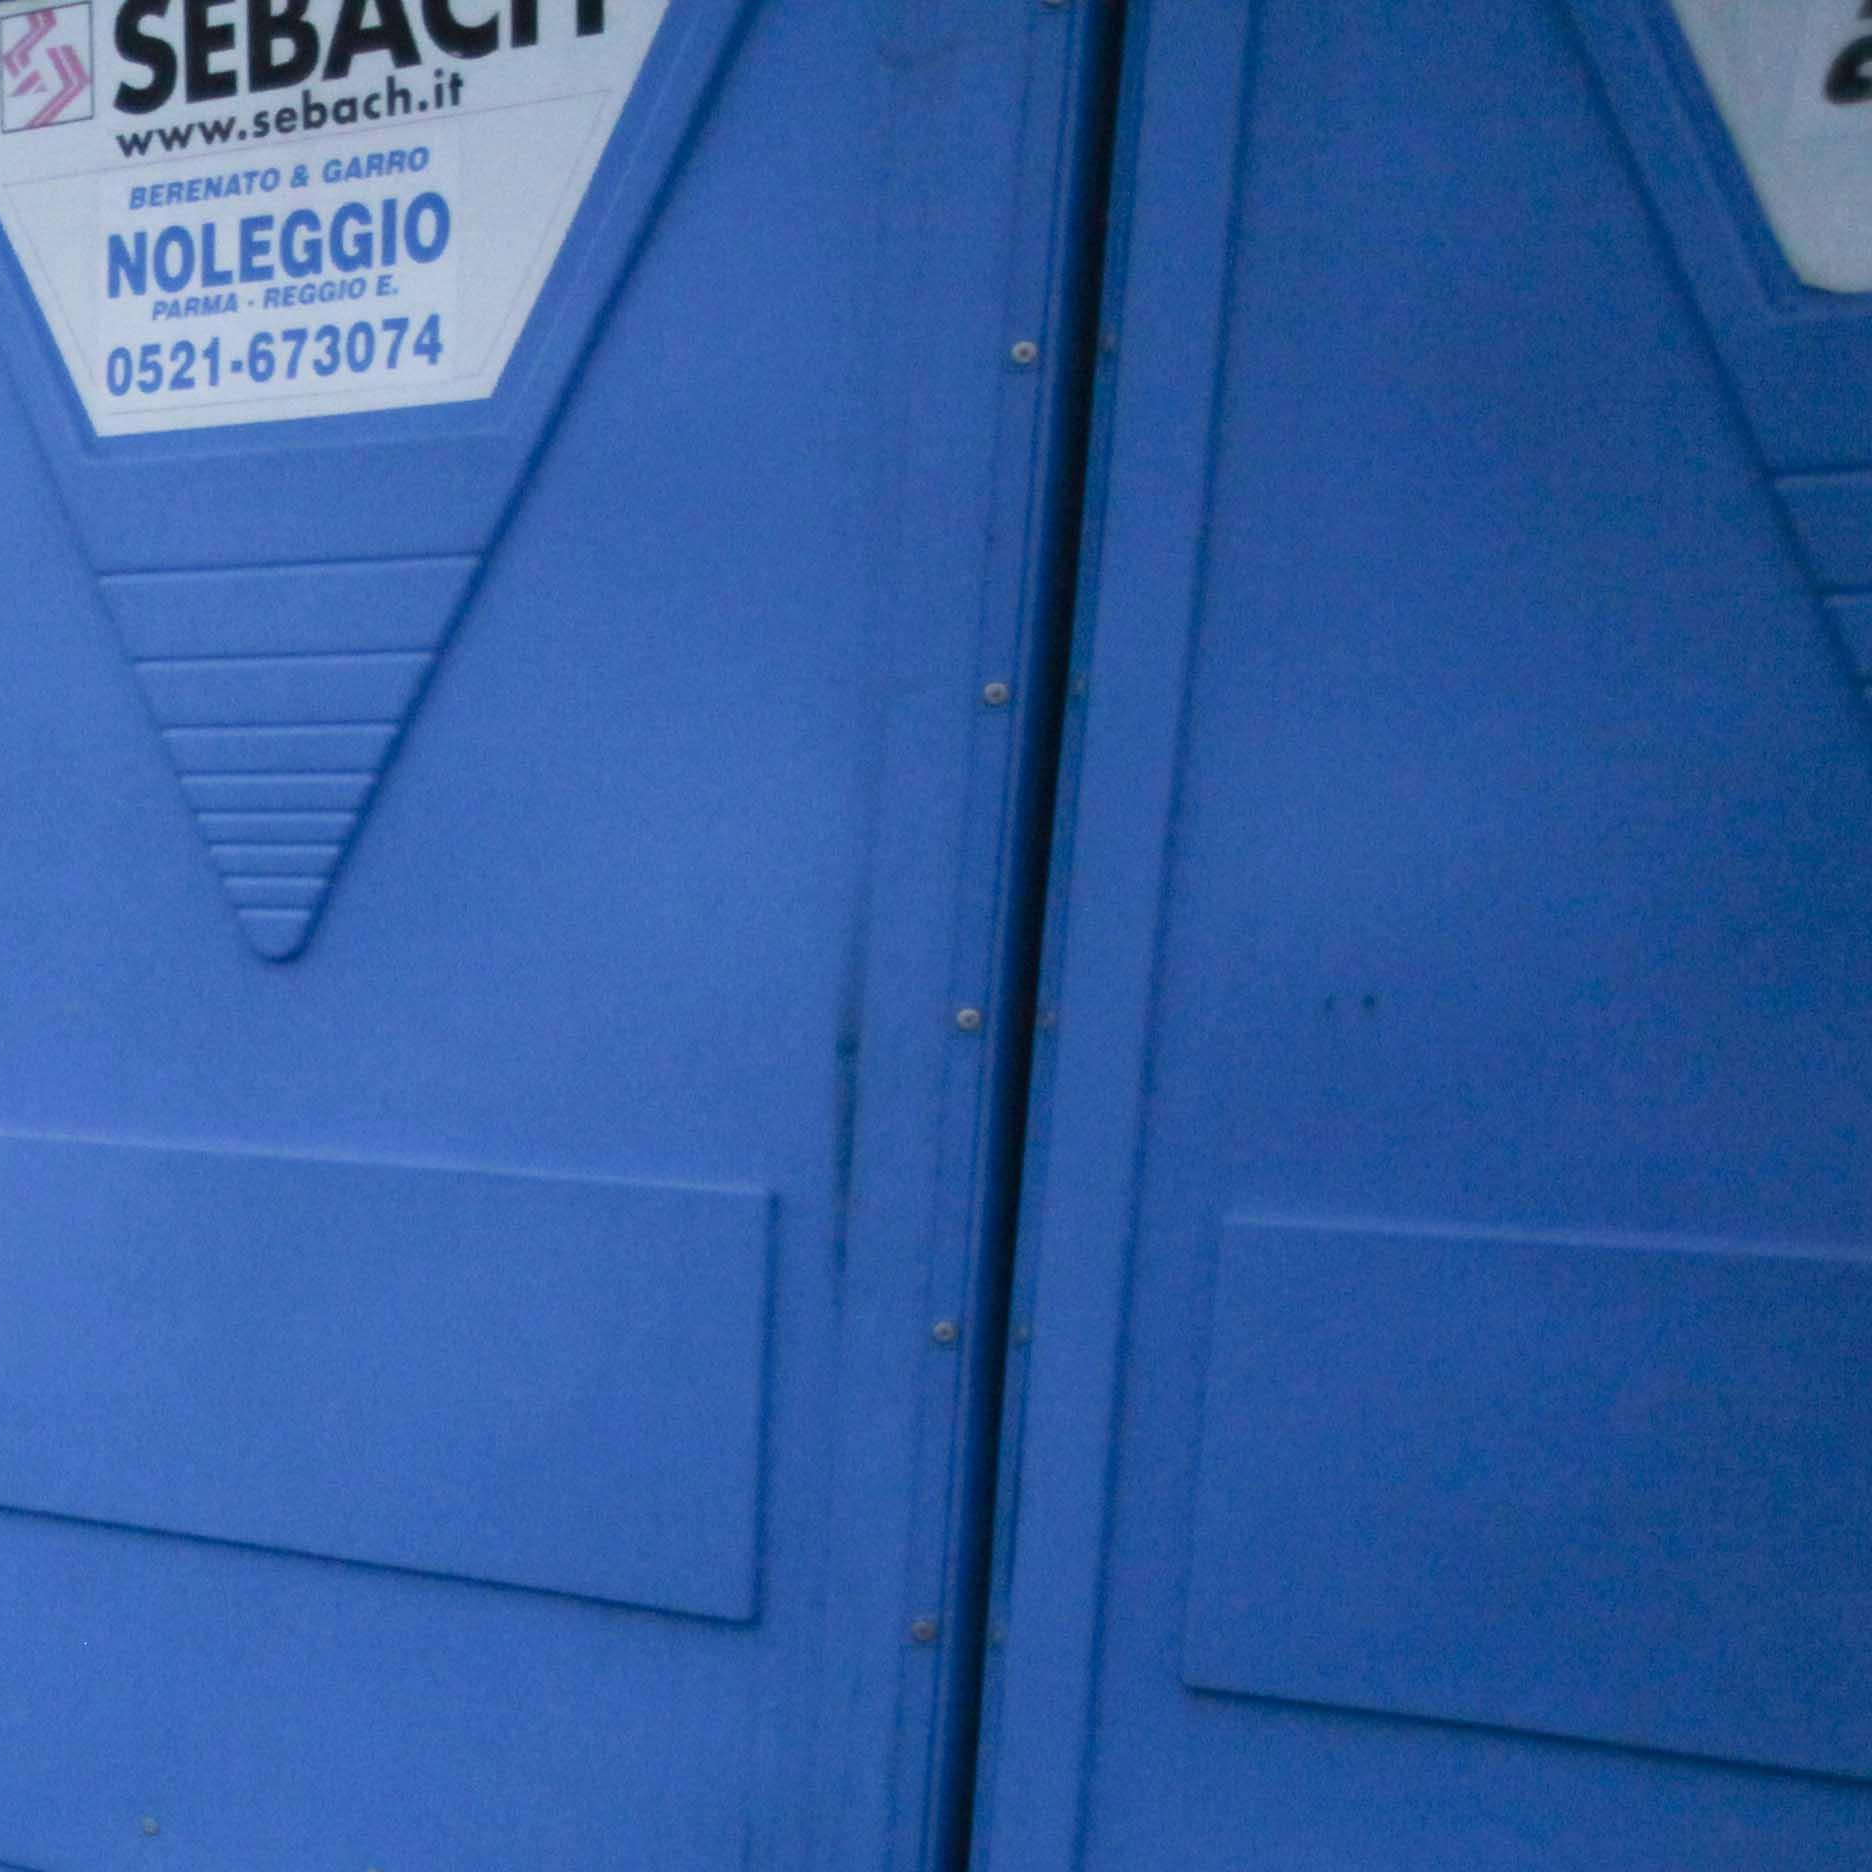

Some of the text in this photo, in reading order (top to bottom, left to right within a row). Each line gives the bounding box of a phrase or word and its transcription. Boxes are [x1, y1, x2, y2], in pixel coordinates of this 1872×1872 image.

[116, 68, 464, 158] www.sebach.it
[128, 147, 430, 210] BERENATO & GARRO
[107, 191, 451, 299] NOLEGGIO
[151, 293, 239, 321] PARMA
[263, 277, 367, 309] REGGIO
[375, 274, 400, 297] E.
[106, 313, 444, 397] 0521-673074
